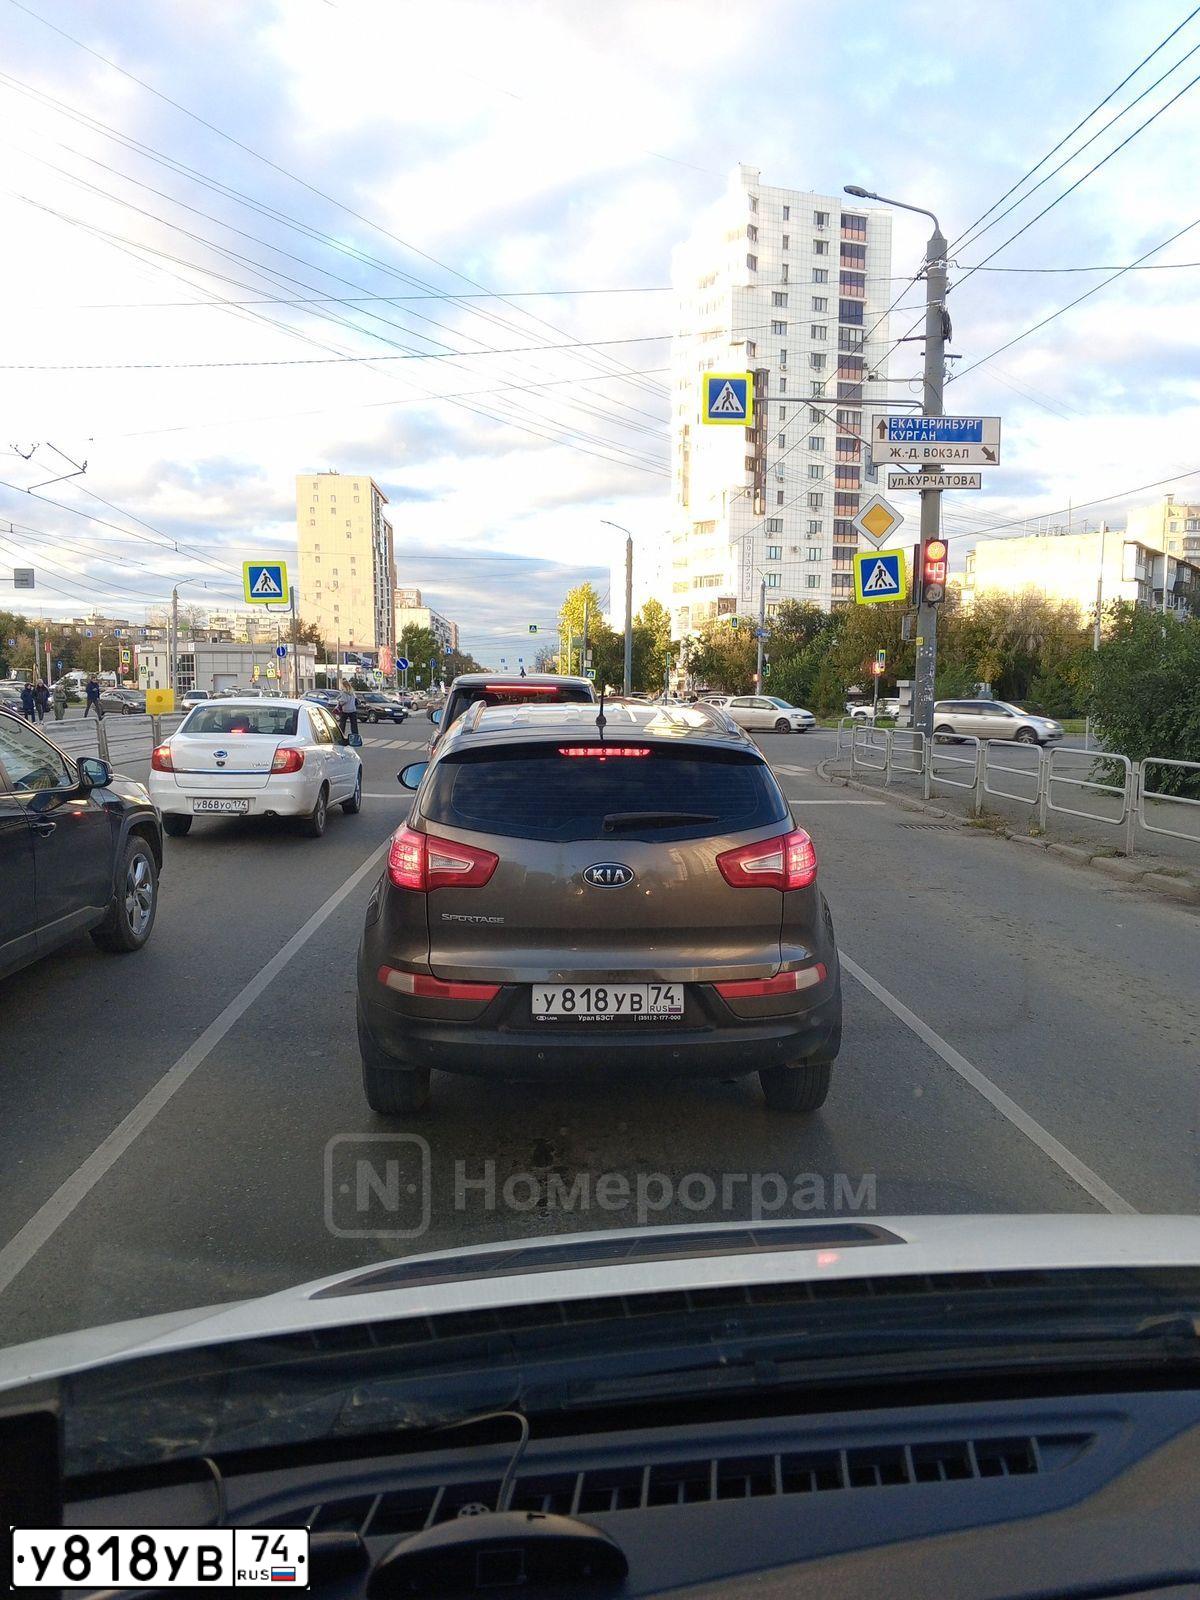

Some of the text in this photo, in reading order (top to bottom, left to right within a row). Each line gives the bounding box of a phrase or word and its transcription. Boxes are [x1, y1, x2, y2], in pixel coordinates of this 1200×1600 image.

[890, 418, 980, 430] ЕКАТЕРИНБУРГ
[890, 430, 936, 441] КУРГАН
[923, 447, 969, 459] ВОКЗАЛ
[591, 868, 625, 883] KIA
[441, 913, 505, 924] SPORTAGE
[651, 986, 675, 1005] 74
[649, 1005, 668, 1013] RUS
[578, 1014, 595, 1022] Урал
